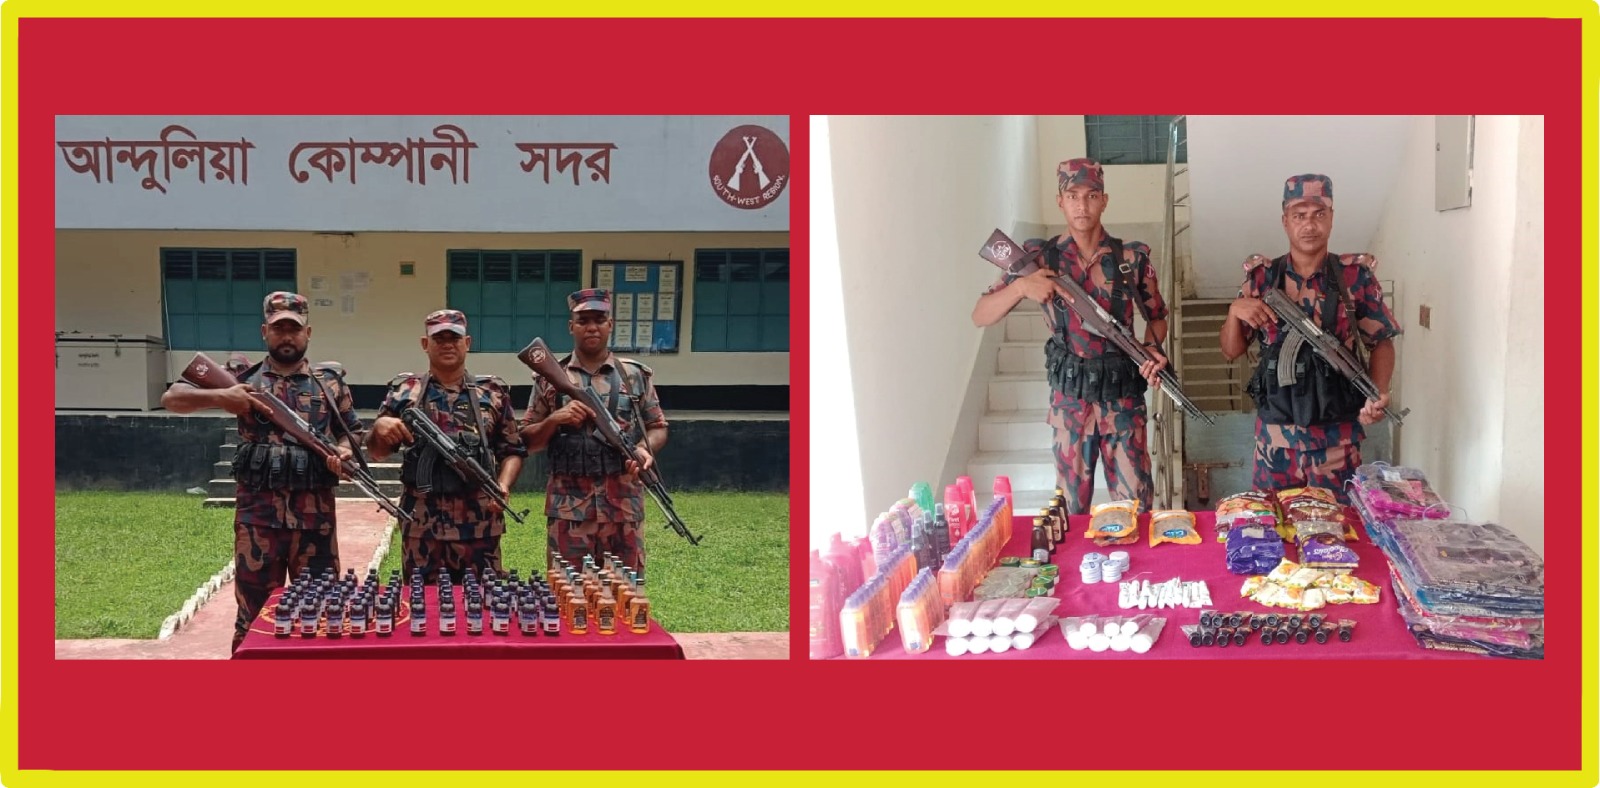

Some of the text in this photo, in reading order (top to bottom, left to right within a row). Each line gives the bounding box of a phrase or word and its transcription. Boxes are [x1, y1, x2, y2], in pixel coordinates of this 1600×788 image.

[56, 124, 618, 194] আন্দুলিয়া কোম্পানী সদর
